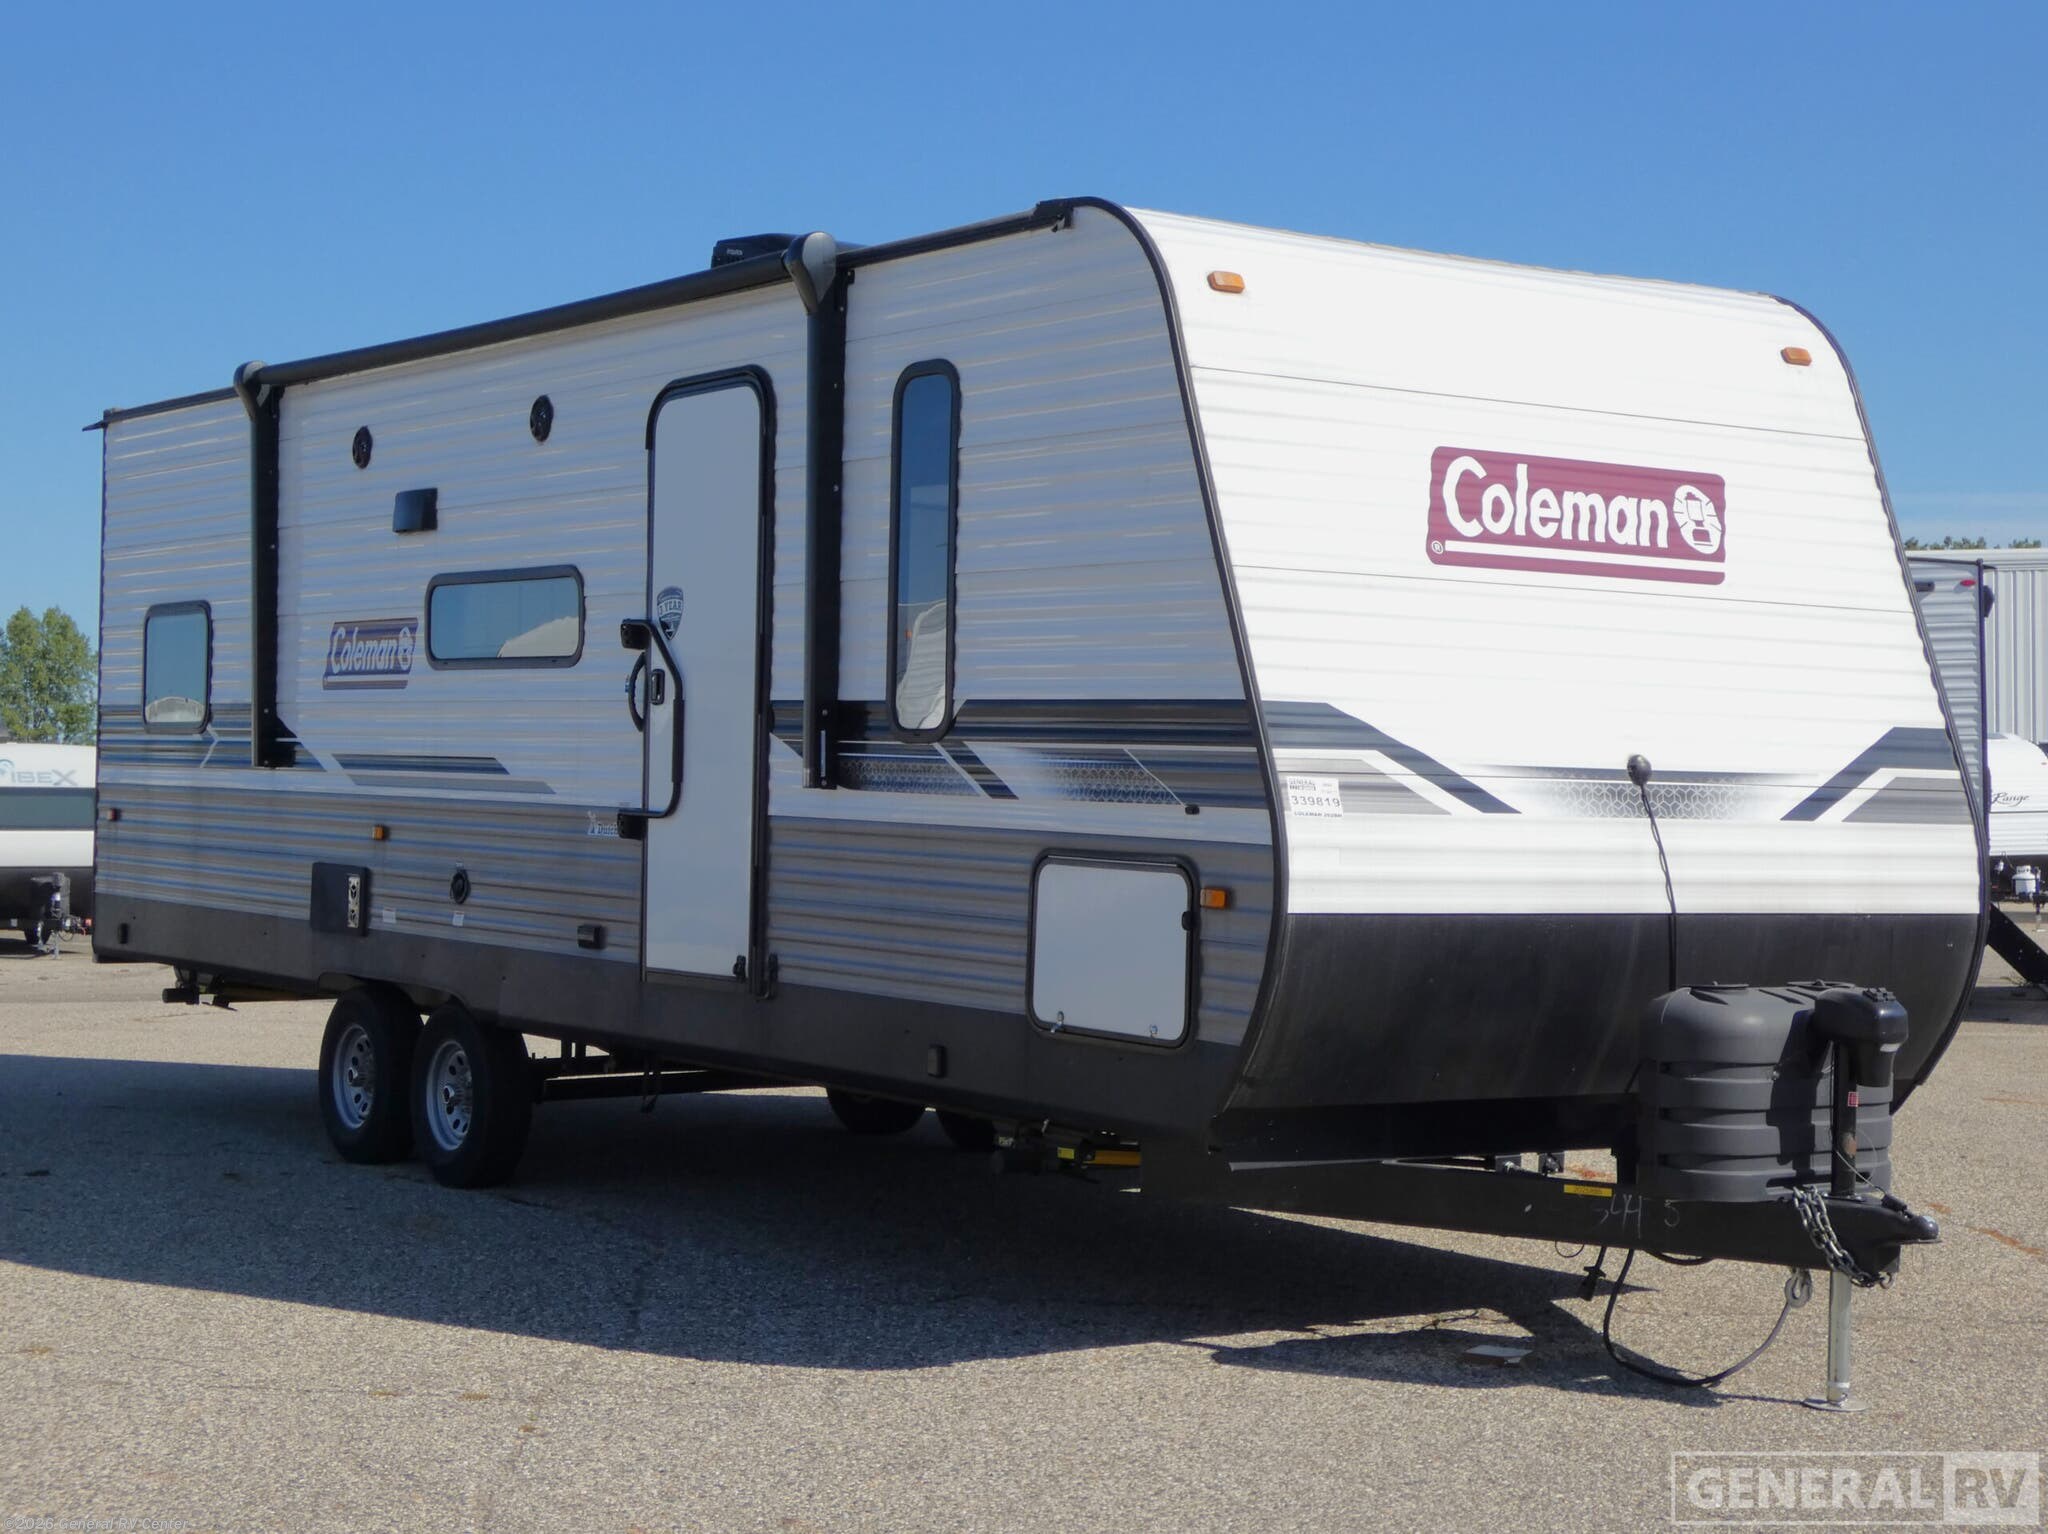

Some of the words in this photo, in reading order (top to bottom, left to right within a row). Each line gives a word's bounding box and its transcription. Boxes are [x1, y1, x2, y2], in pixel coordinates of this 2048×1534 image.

[1443, 456, 1668, 548] Coleman
[331, 627, 397, 674] Coleman
[11, 769, 79, 786] IBEX
[1291, 795, 1341, 809] 339819
[1991, 791, 2030, 807] Range
